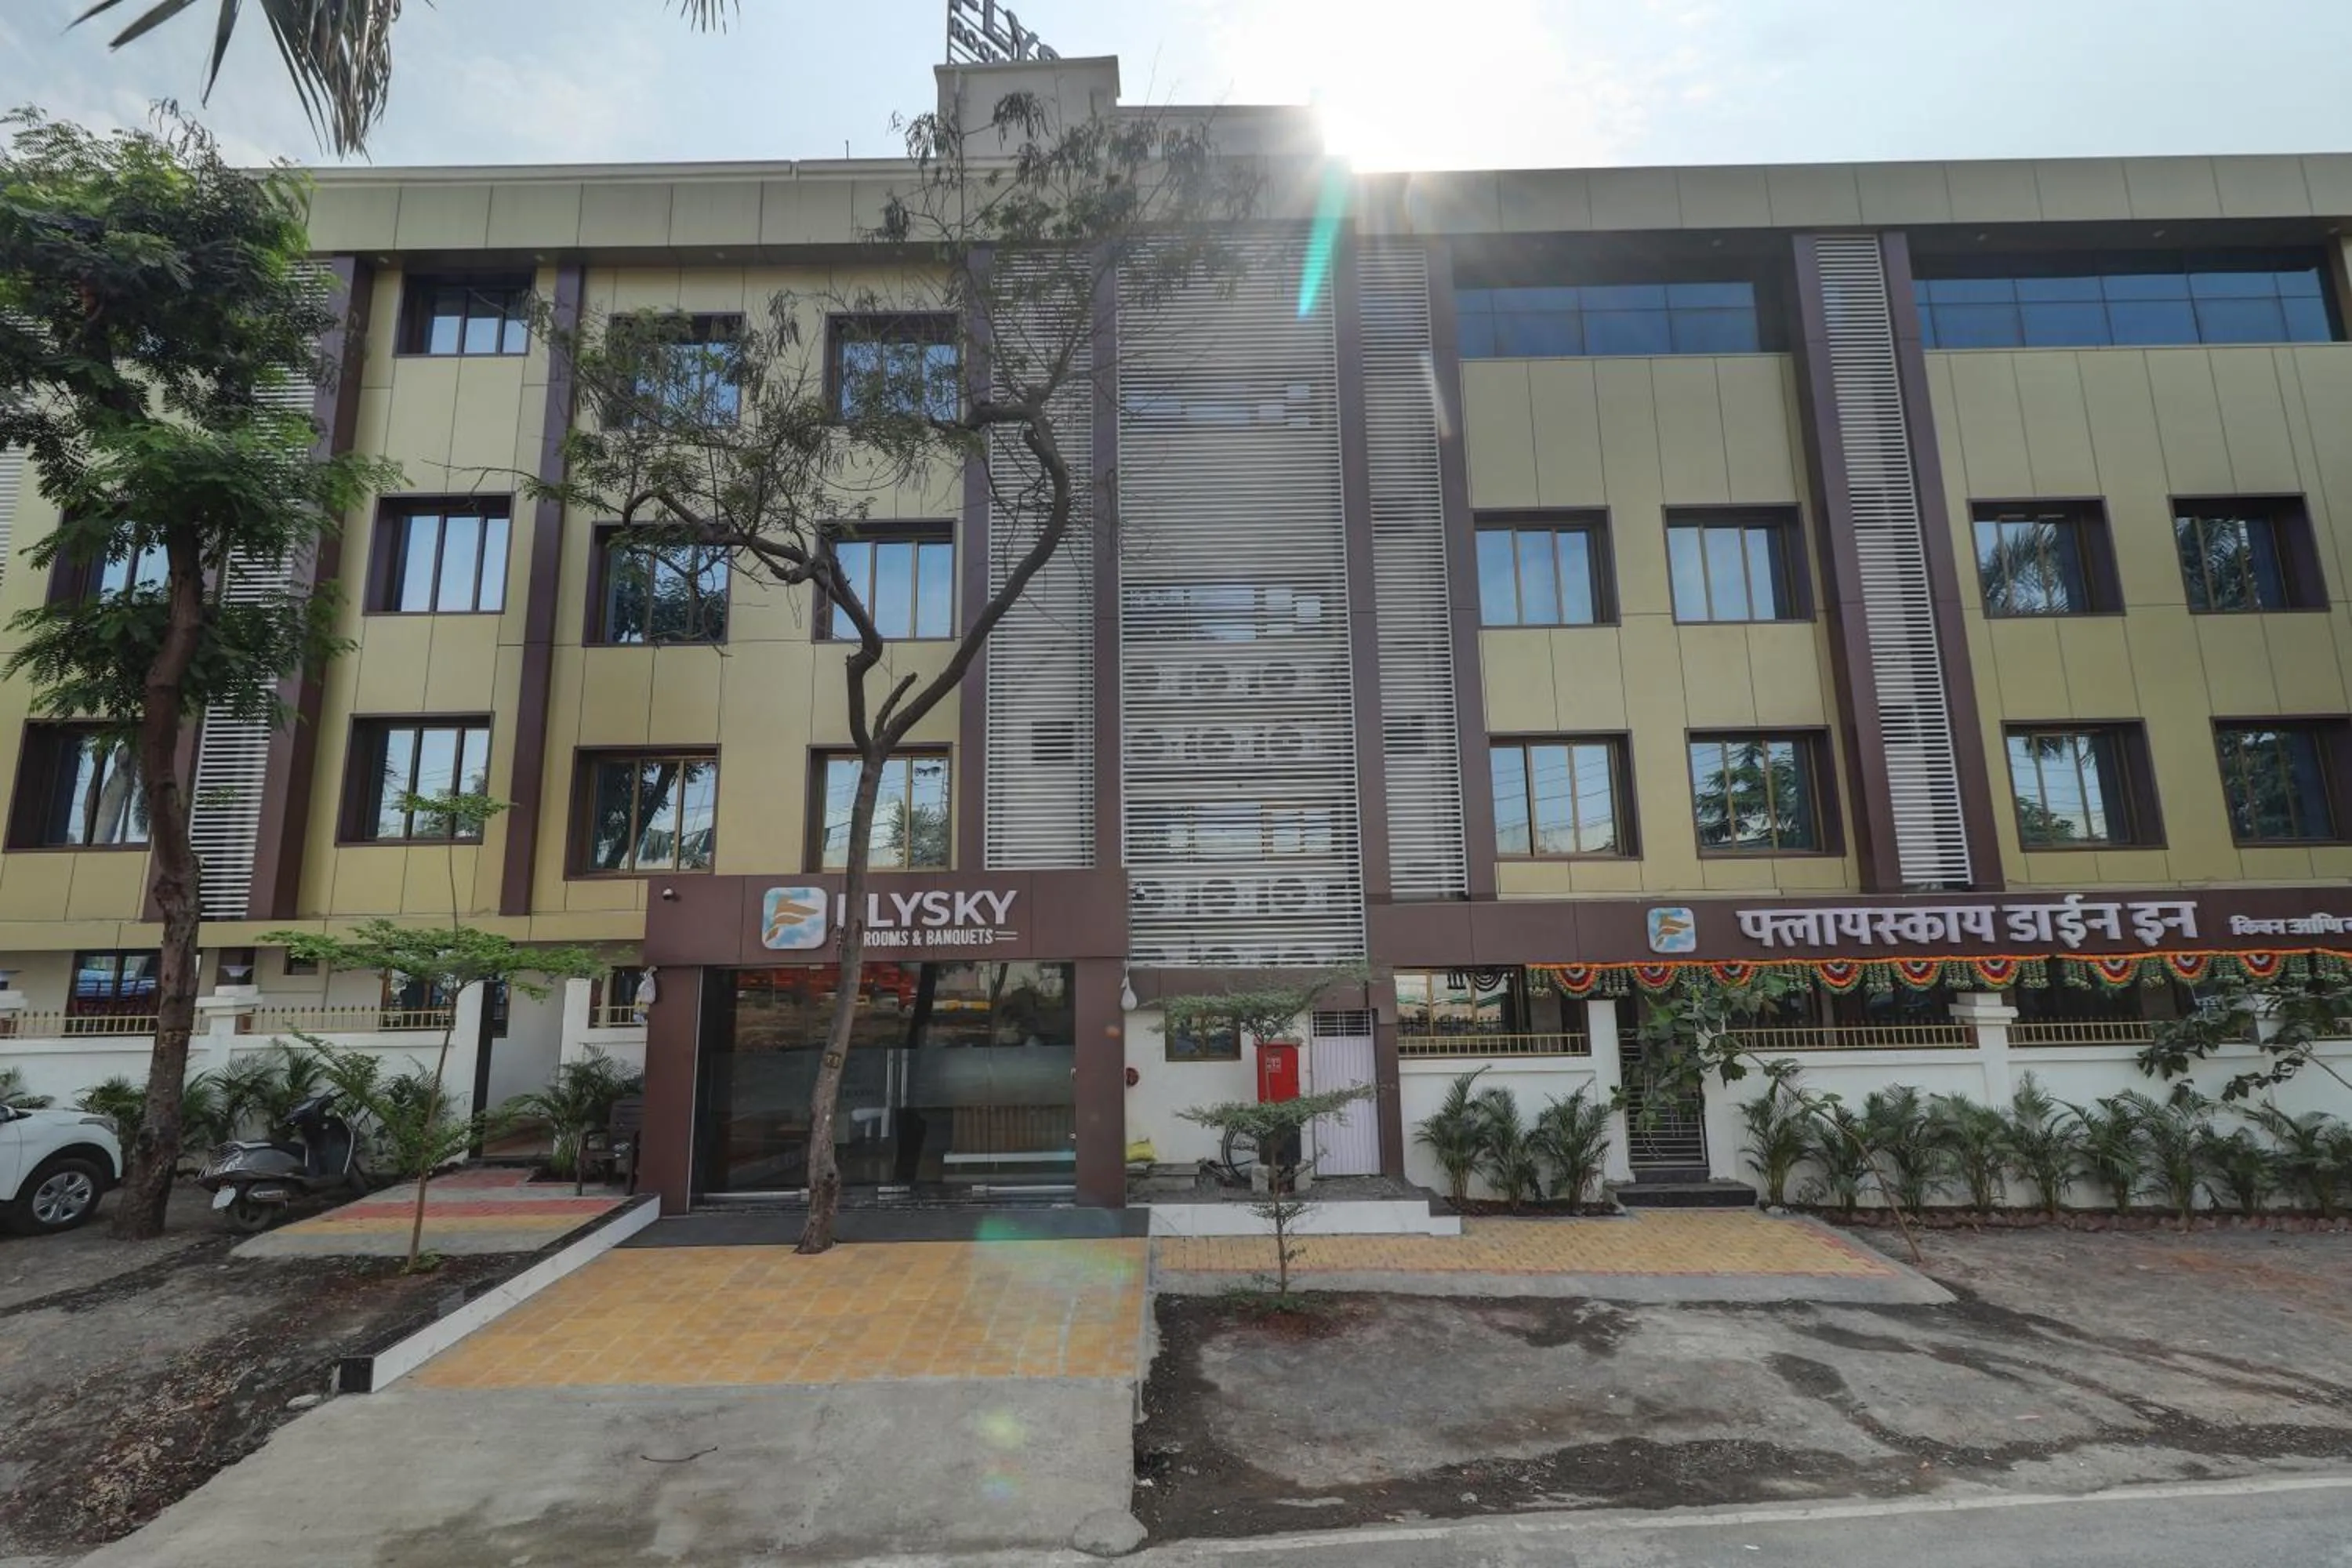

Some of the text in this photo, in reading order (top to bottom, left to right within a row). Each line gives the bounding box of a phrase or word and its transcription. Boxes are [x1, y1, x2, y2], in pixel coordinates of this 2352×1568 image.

[863, 927, 993, 948] ROOMS & BANQUETS
[1735, 905, 1996, 948] फ्लायस्काय
[2002, 894, 2122, 949] डाईन
[2126, 901, 2198, 947] इन
